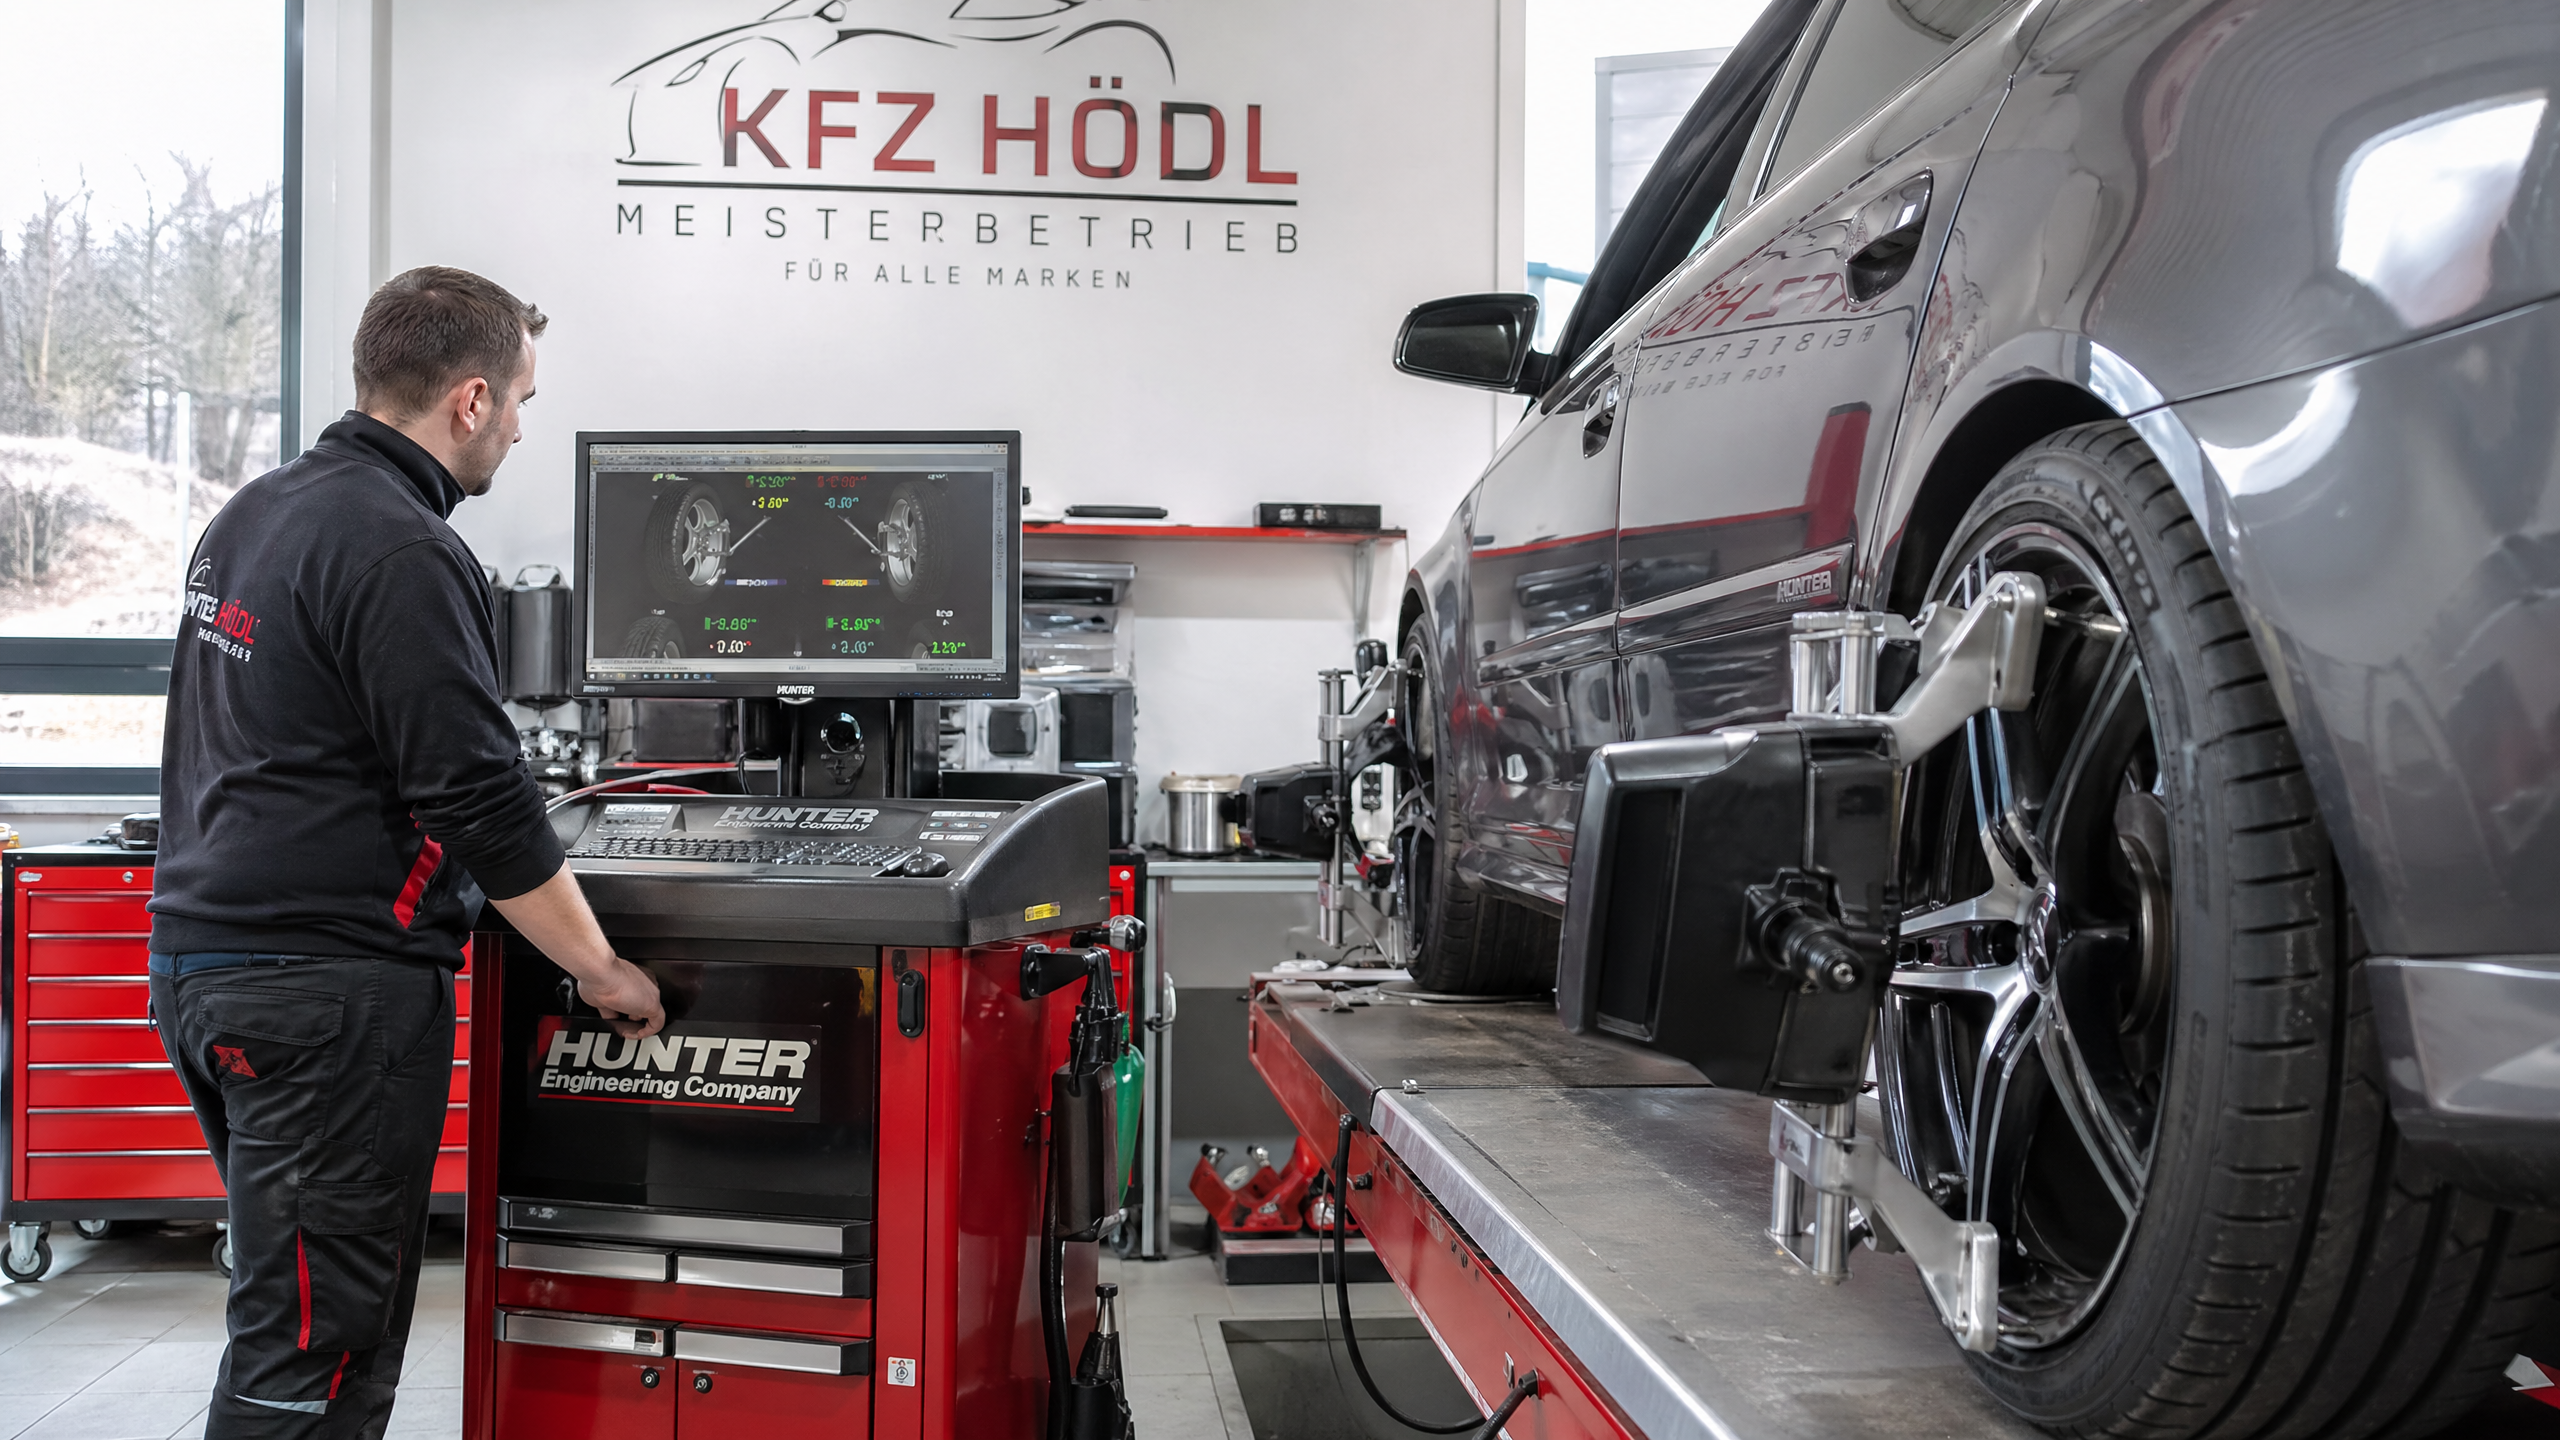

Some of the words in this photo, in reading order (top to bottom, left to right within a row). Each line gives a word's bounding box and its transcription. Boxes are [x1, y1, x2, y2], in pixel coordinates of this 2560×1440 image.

[723, 88, 936, 173] KFZ
[982, 75, 1299, 185] HÖDL
[617, 203, 1299, 254] MEISTERBETRIEB
[785, 259, 849, 283] FÜR
[874, 263, 960, 285] ALLE
[987, 266, 1131, 289] MARKEN
[213, 599, 256, 645] HÖDL
[720, 806, 880, 824] HUNTER
[545, 1030, 811, 1079] HUNTER
[540, 1067, 681, 1100] Engineering
[684, 1075, 802, 1106] Company
